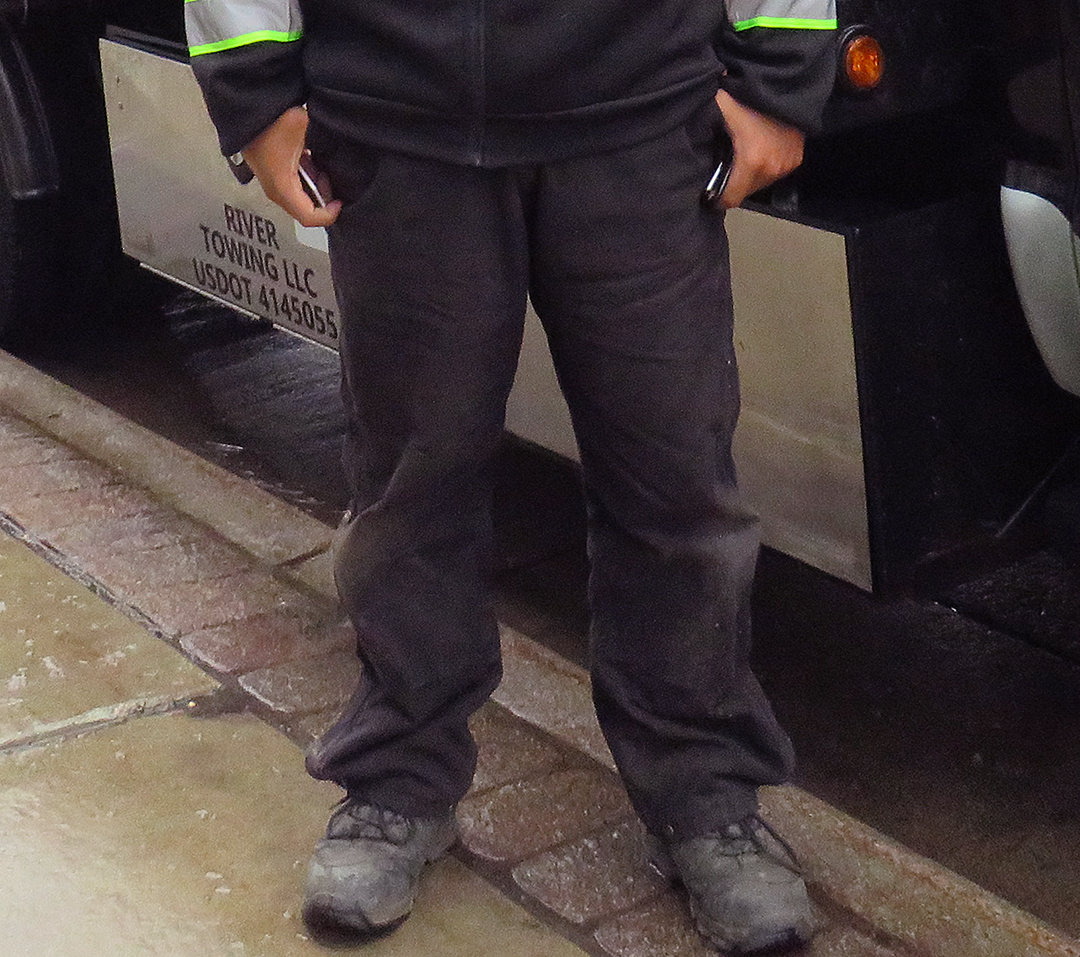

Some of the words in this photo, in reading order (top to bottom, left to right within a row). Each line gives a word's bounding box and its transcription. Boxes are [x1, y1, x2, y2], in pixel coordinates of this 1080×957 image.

[200, 224, 279, 282] TOWING
[283, 259, 318, 299] LLC
[225, 203, 279, 250] RIVER
[193, 257, 252, 305] USDOT
[258, 285, 338, 339] 4145055
